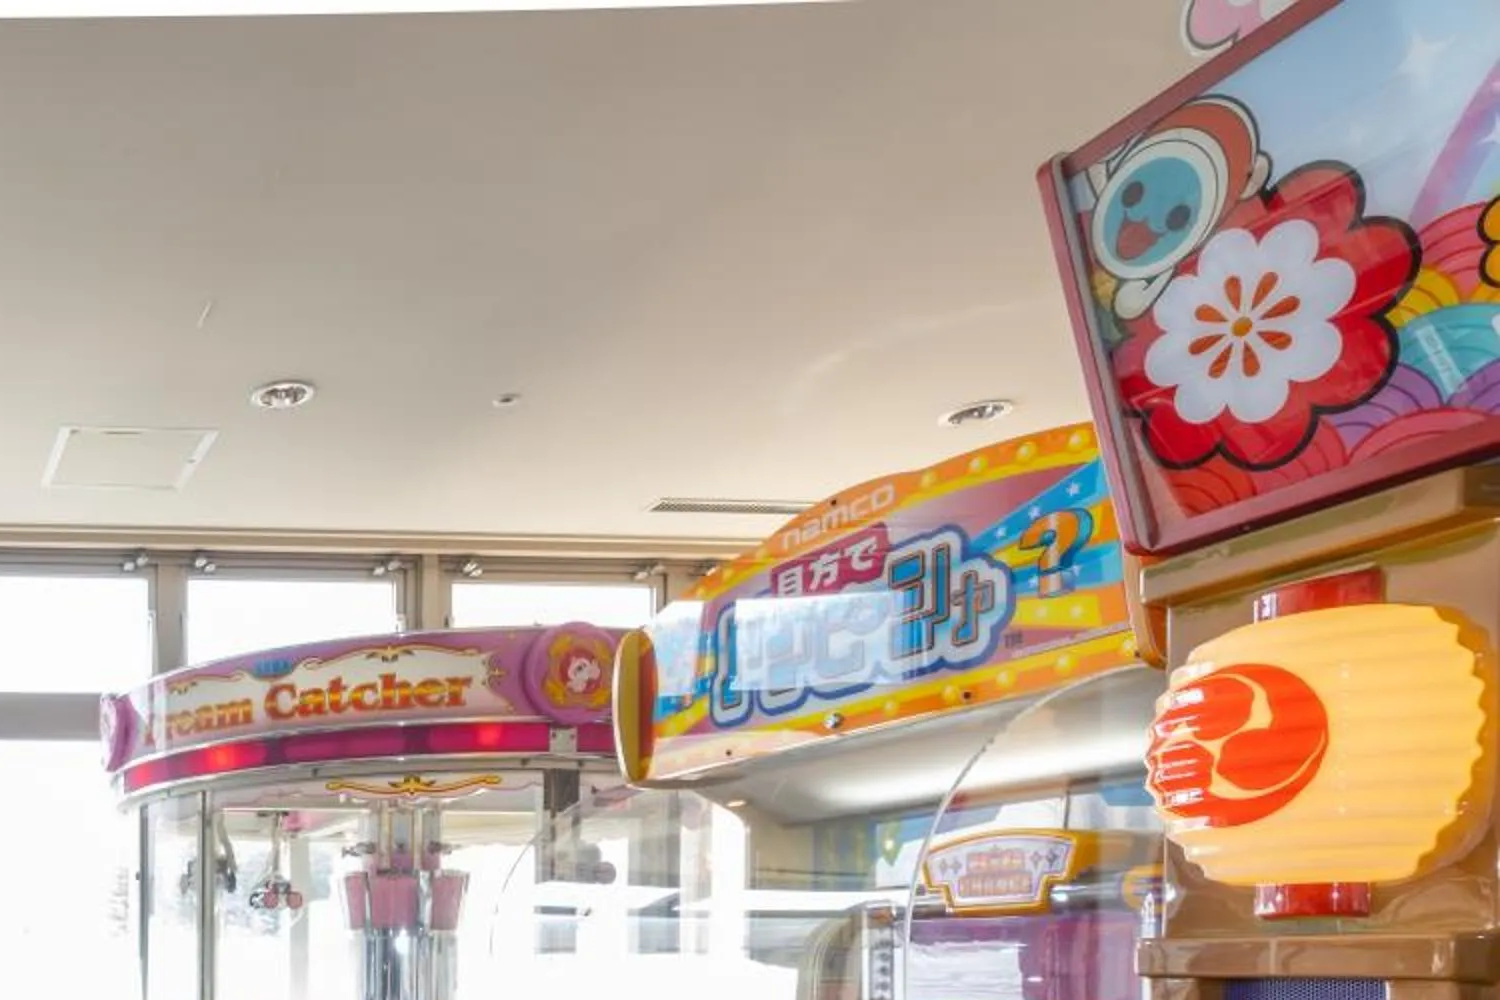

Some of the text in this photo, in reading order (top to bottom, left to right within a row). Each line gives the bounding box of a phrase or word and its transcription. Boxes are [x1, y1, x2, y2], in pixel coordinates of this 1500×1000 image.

[781, 484, 896, 551] namco
[777, 534, 880, 598] 目方で
[263, 673, 474, 721] Catcher
